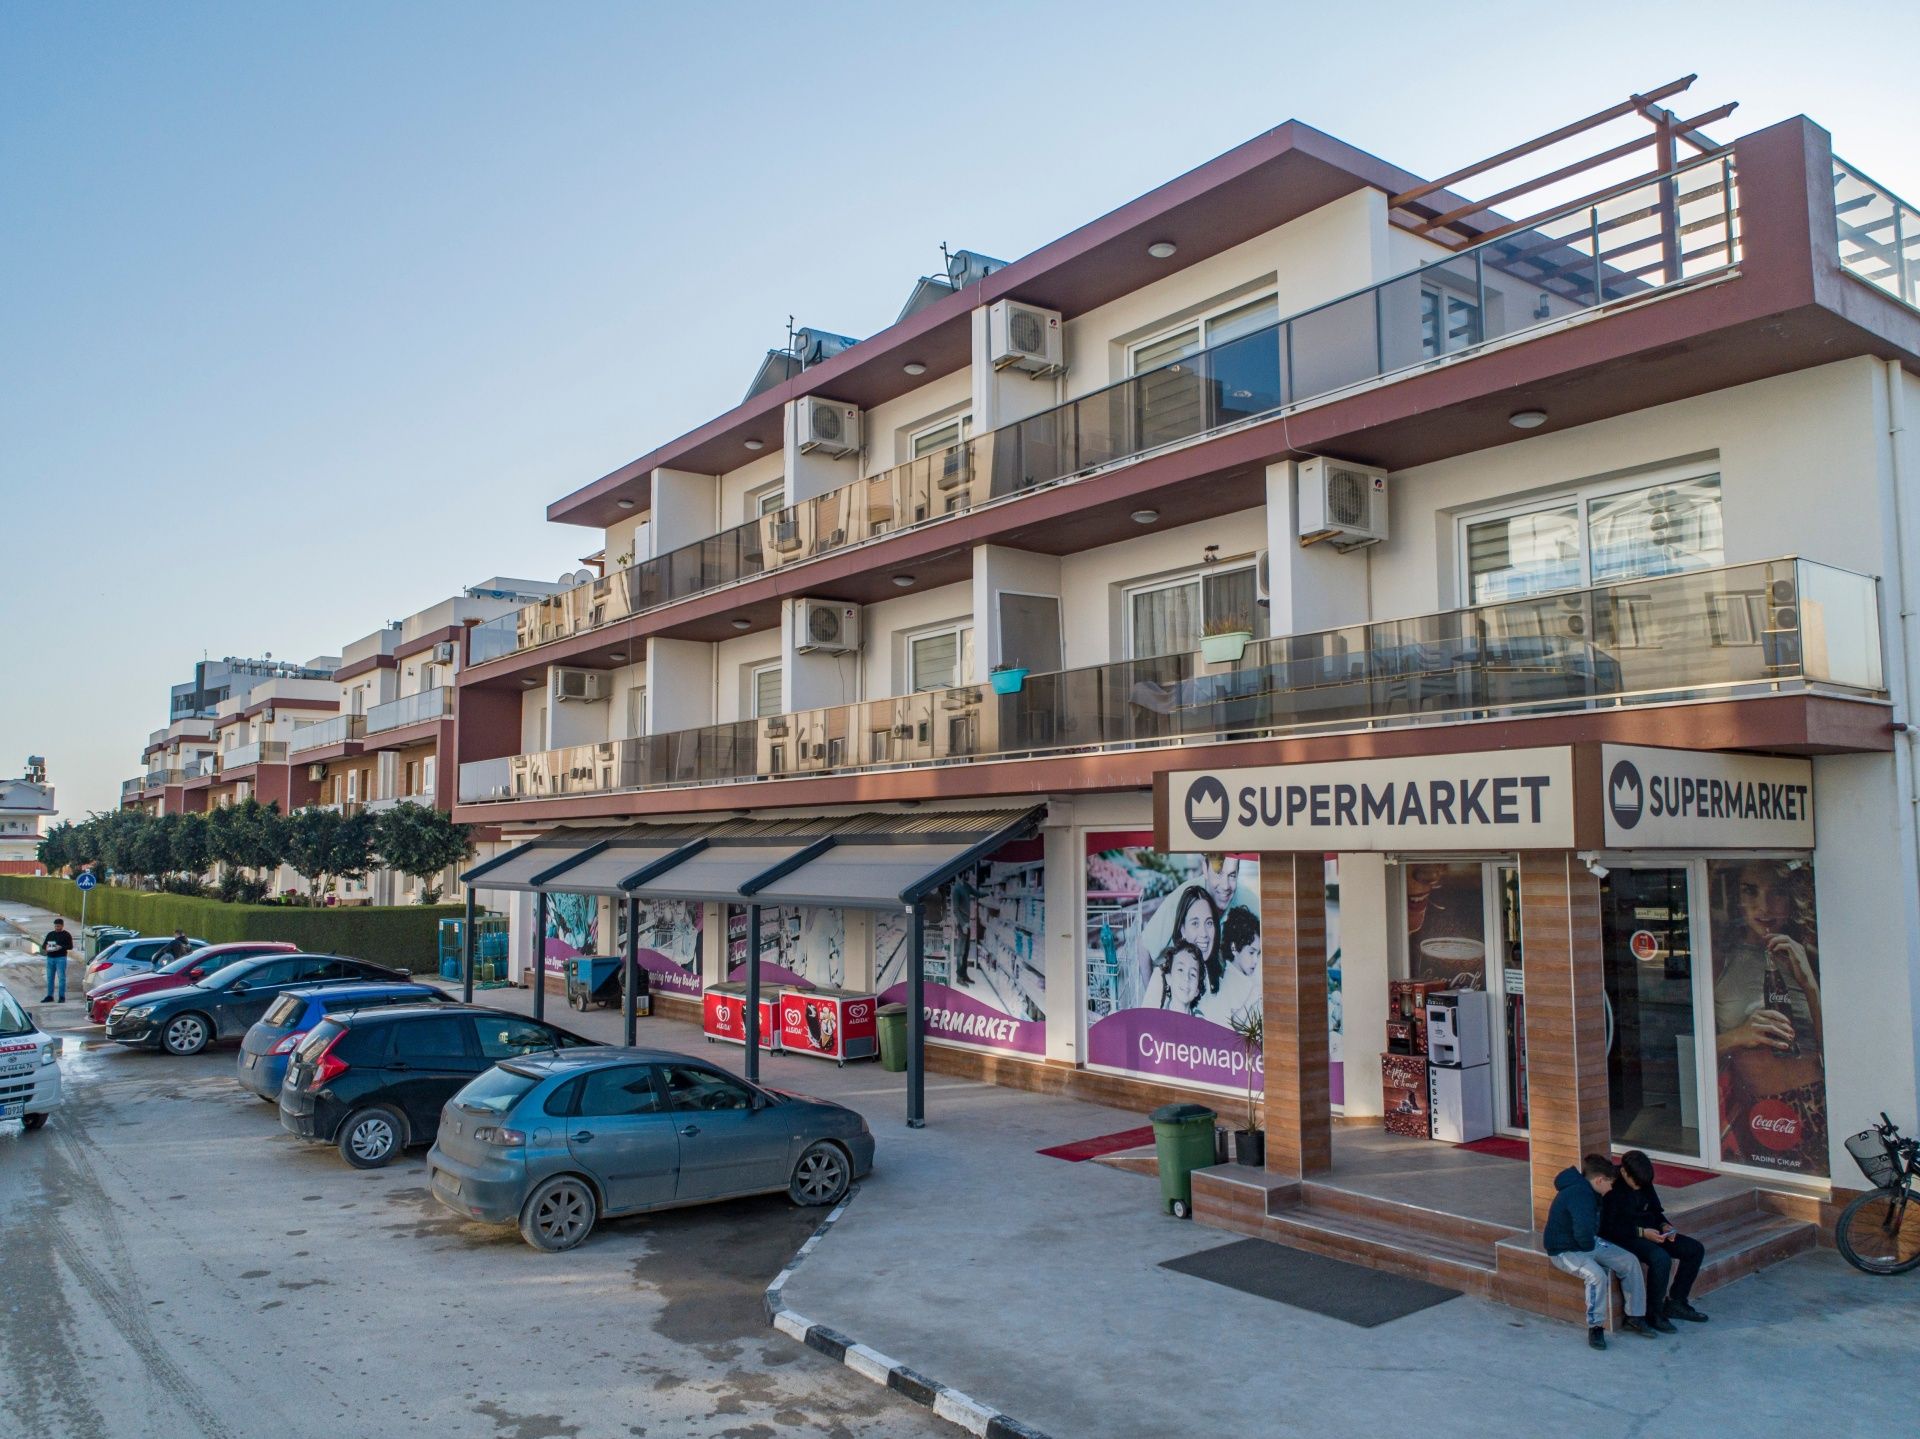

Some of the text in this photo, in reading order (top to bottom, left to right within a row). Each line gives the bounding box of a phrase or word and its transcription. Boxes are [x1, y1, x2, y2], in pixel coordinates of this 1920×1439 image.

[1237, 775, 1551, 827] SUPERMARKET
[1649, 775, 1808, 821] SUPERMARKET
[682, 973, 700, 991] Budget
